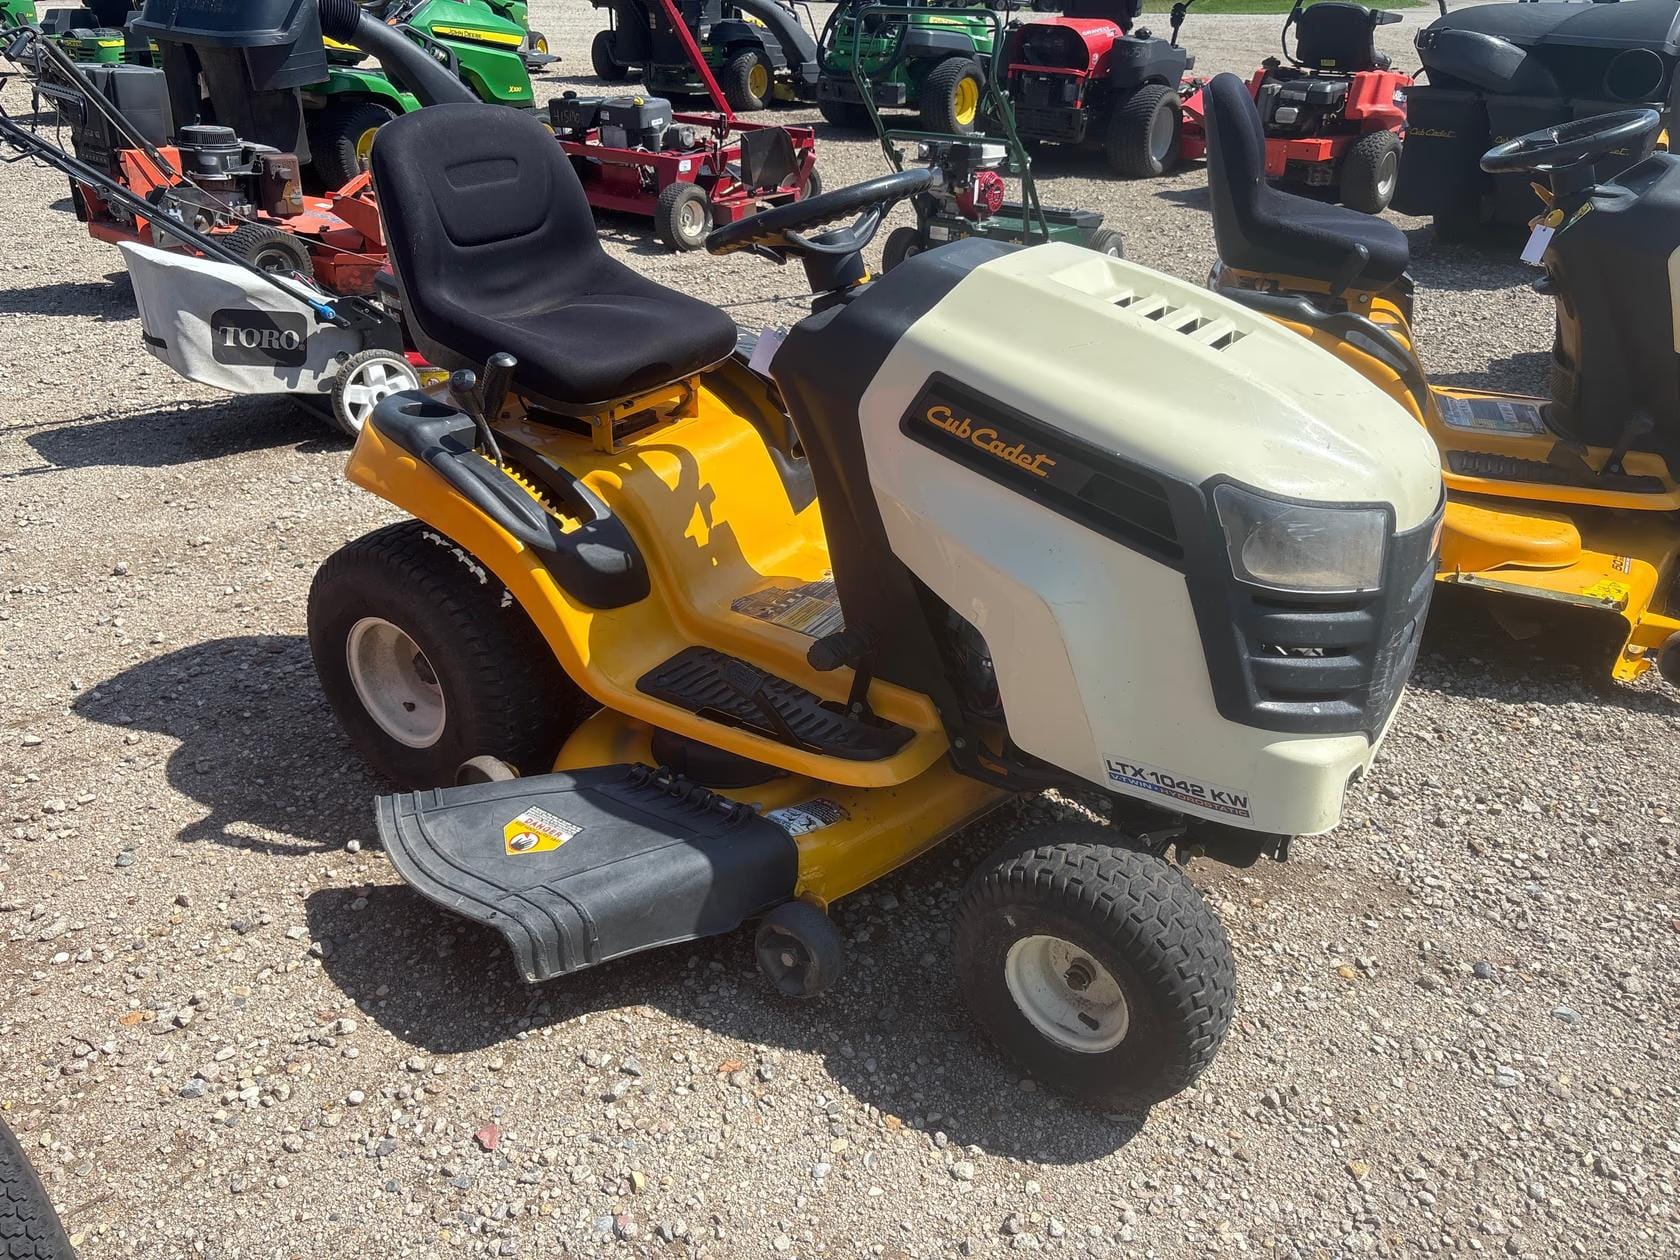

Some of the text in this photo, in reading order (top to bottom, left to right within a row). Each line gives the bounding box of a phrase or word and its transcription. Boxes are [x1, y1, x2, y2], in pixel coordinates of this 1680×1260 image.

[218, 326, 300, 350] TORO
[926, 405, 1057, 478] Cub Cadet
[1106, 759, 1248, 809] LTX 1042 KW
[1110, 773, 1248, 817] V-TWIN HYDROSTATIC
[524, 817, 562, 838] DANGER
